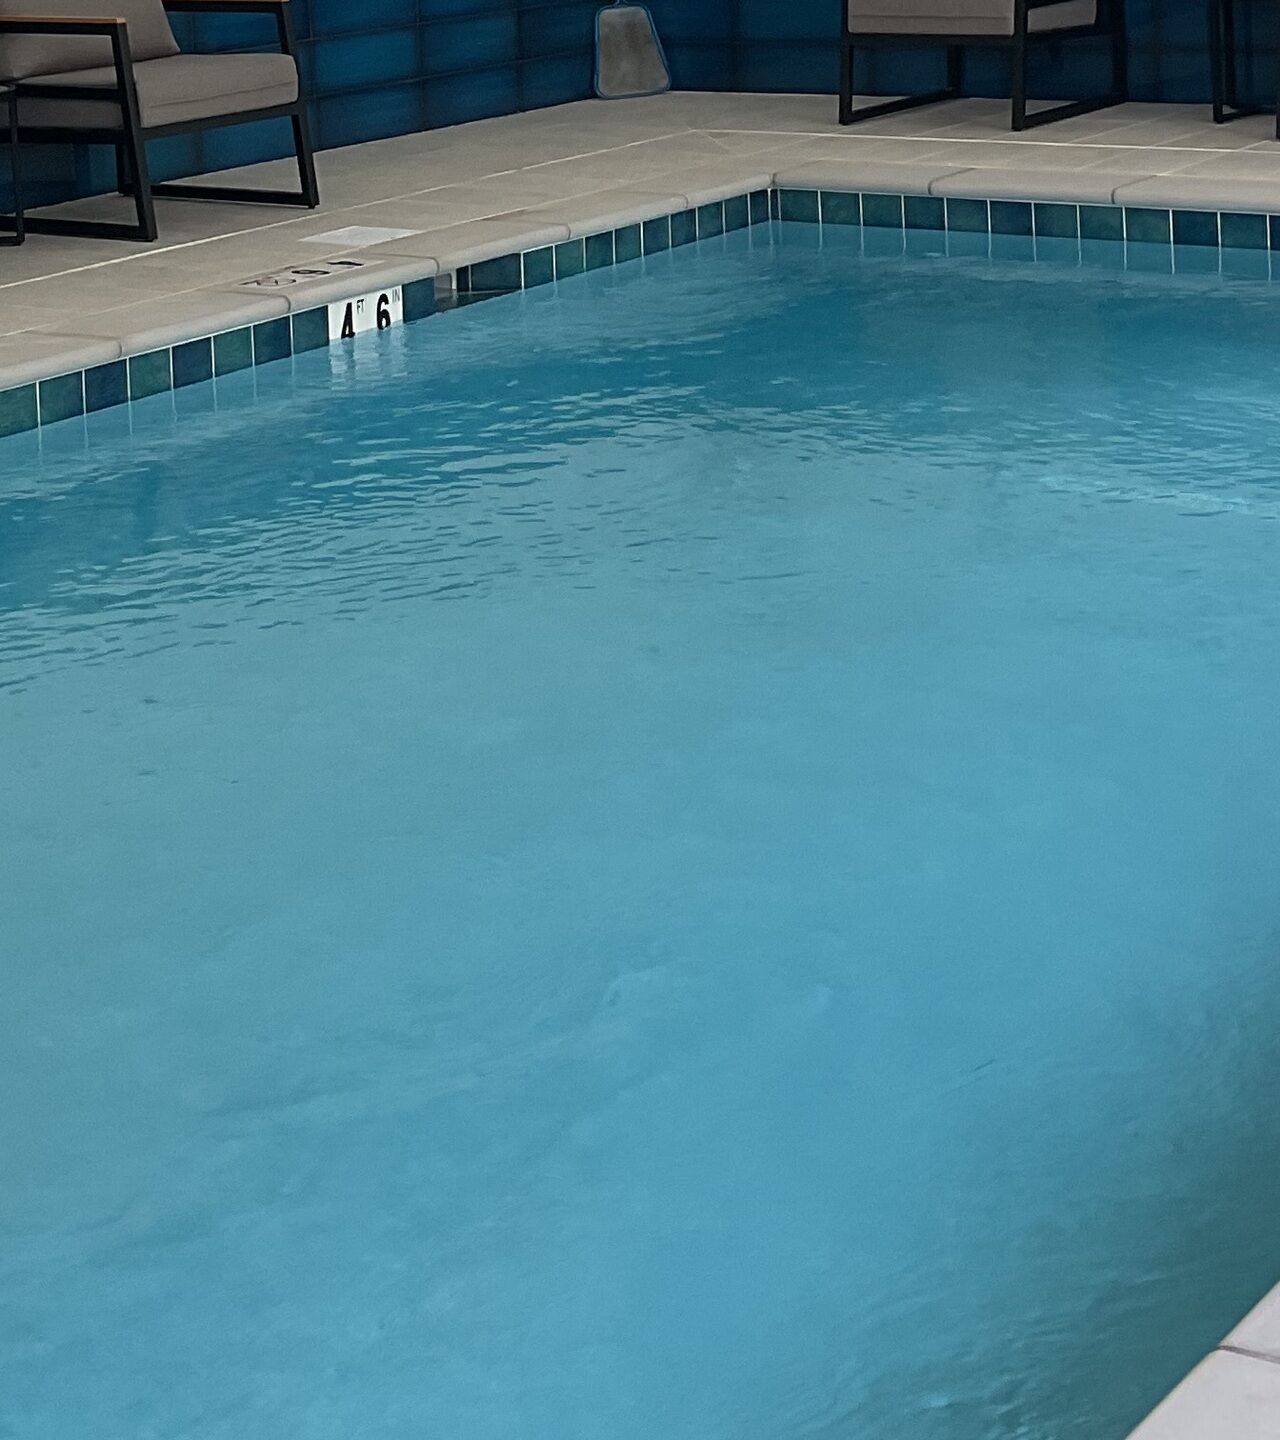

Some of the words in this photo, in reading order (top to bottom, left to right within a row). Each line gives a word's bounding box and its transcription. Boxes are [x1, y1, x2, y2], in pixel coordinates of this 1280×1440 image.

[340, 302, 356, 340] 4
[356, 298, 365, 315] FT
[376, 293, 391, 331] 6
